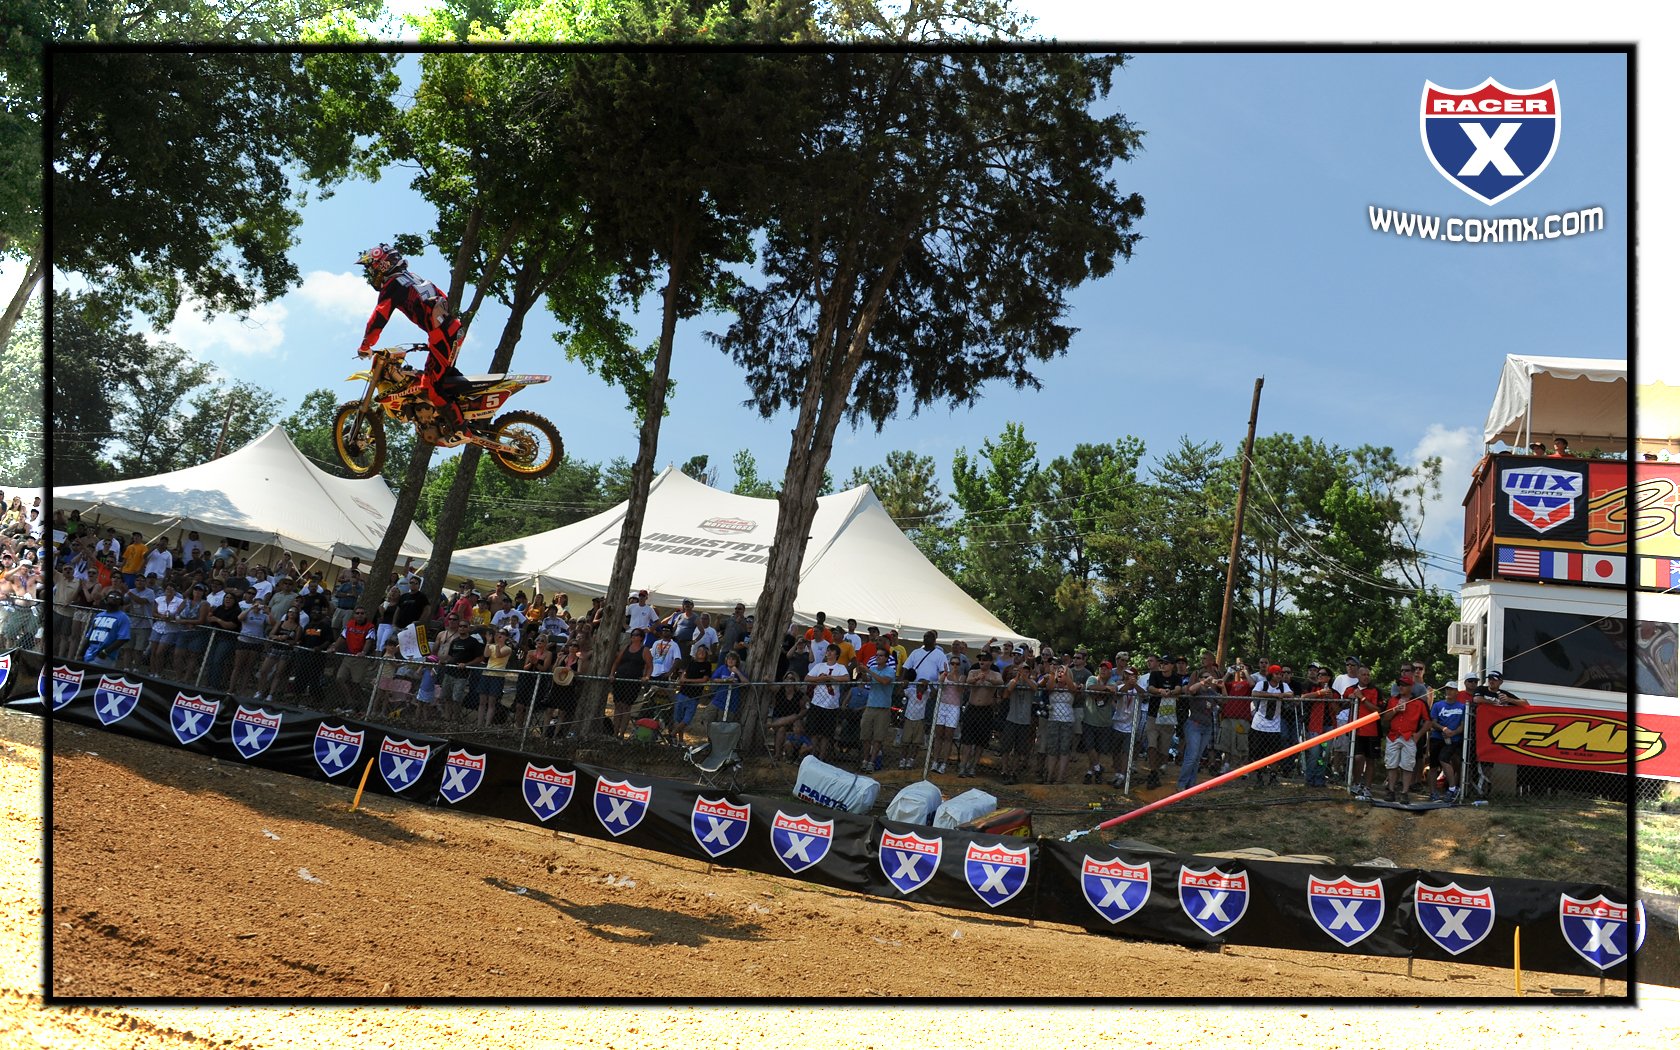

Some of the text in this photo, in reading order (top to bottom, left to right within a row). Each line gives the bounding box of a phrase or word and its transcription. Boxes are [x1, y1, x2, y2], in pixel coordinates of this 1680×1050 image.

[485, 393, 500, 409] 5
[1520, 489, 1563, 497] SPORTS
[602, 537, 725, 558] CMFORT
[642, 533, 770, 553] INDUSTRY
[53, 672, 80, 682] ACER
[53, 680, 69, 703] X
[101, 682, 137, 695] RACER
[99, 692, 126, 717] X
[177, 699, 214, 713] RACER
[177, 710, 204, 735] X
[238, 713, 277, 727] RACER
[237, 724, 266, 750] X
[319, 730, 359, 744] RACER
[1493, 720, 1663, 754] FMF
[320, 741, 348, 767] X
[384, 744, 425, 759] RACER
[387, 756, 414, 783] X
[447, 756, 481, 769] ACER
[442, 766, 471, 793] X
[528, 771, 571, 785] RACER
[533, 782, 560, 811] X
[599, 785, 646, 801] RACER
[604, 796, 633, 827] X
[699, 804, 745, 819] RACER
[702, 816, 734, 847] X
[778, 819, 828, 835] RACER
[782, 831, 816, 863] X
[885, 838, 936, 853] RACER
[891, 851, 923, 882] X
[970, 851, 1024, 865] RACER
[977, 863, 1012, 896] X
[1087, 865, 1145, 879] RACER
[1185, 876, 1243, 889] RACER
[1313, 885, 1377, 897] RACER
[1097, 878, 1132, 911] X
[1421, 892, 1487, 907] RACER
[1195, 889, 1231, 923] X
[1328, 898, 1366, 932] X
[1434, 906, 1474, 941] X
[1581, 919, 1622, 956] X
